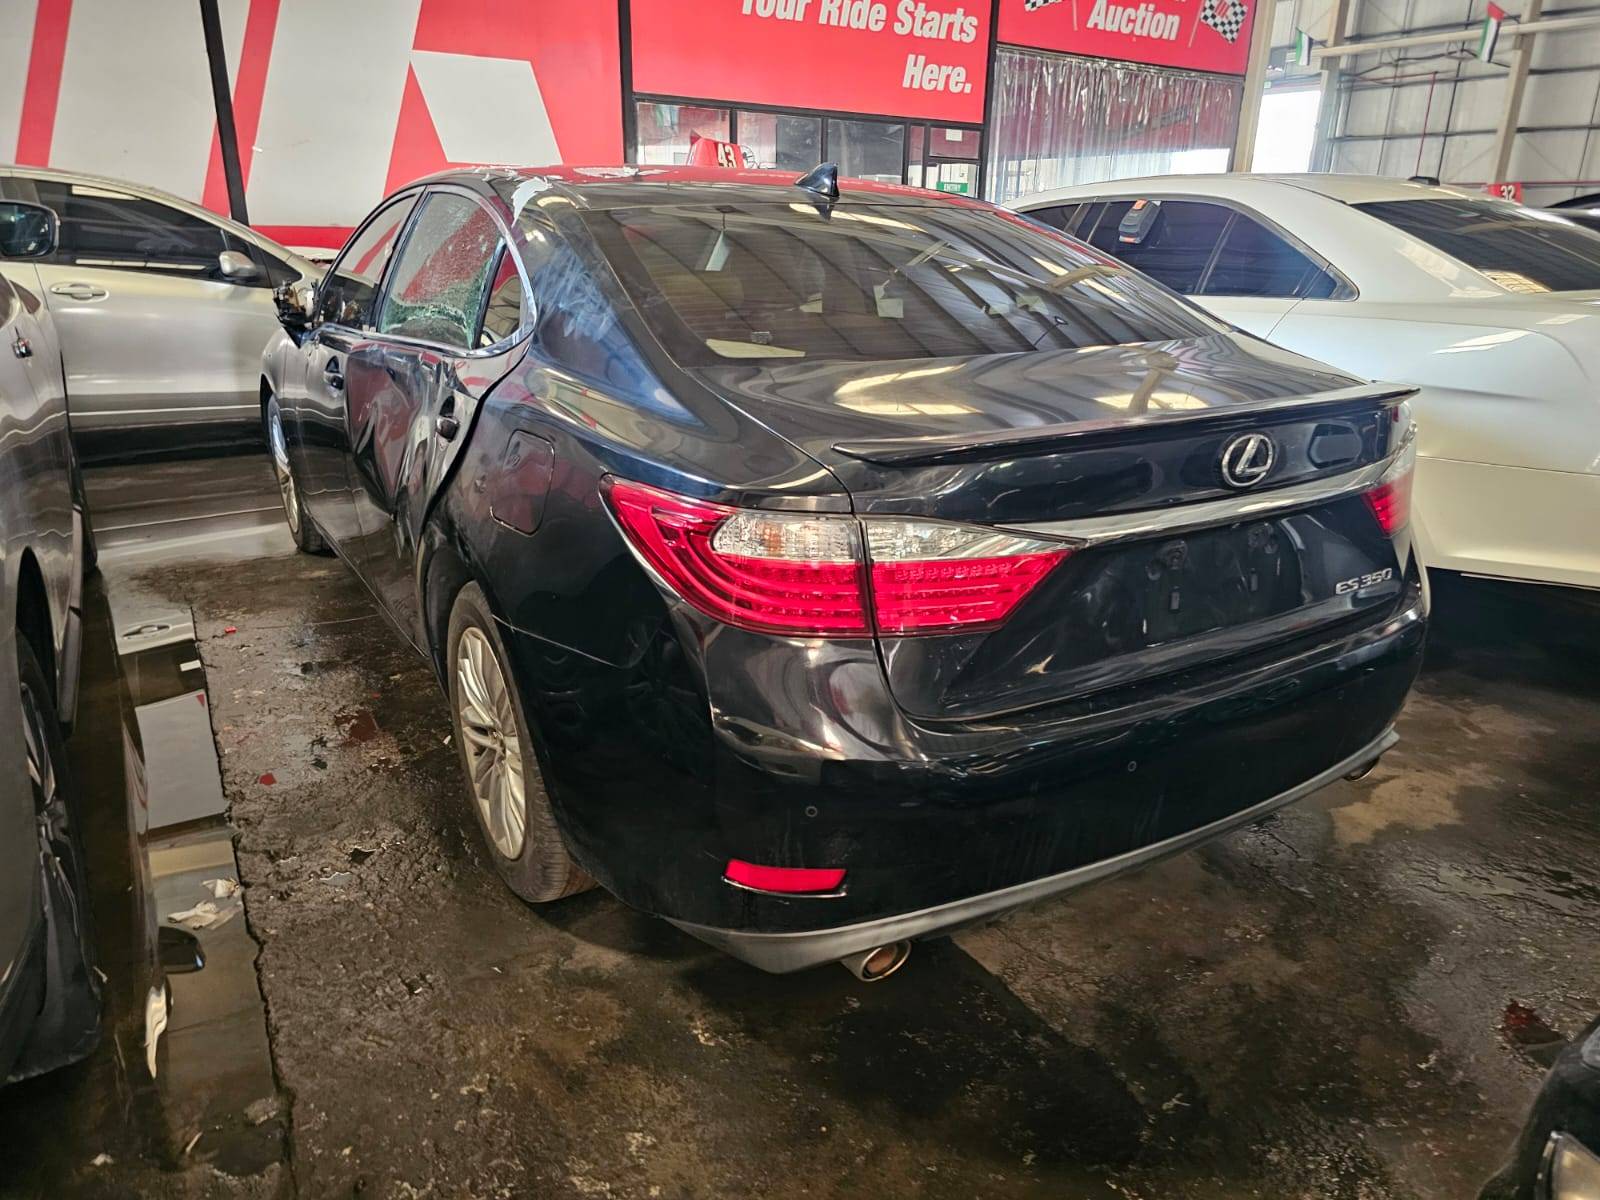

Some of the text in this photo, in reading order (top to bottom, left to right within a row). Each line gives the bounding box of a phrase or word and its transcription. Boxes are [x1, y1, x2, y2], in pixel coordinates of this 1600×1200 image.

[819, 0, 886, 31] Ride
[893, 0, 978, 43] Starts
[1086, 1, 1180, 41] Auction
[902, 54, 972, 93] Here.
[717, 143, 737, 168] 43
[1335, 567, 1393, 595] ES 350
